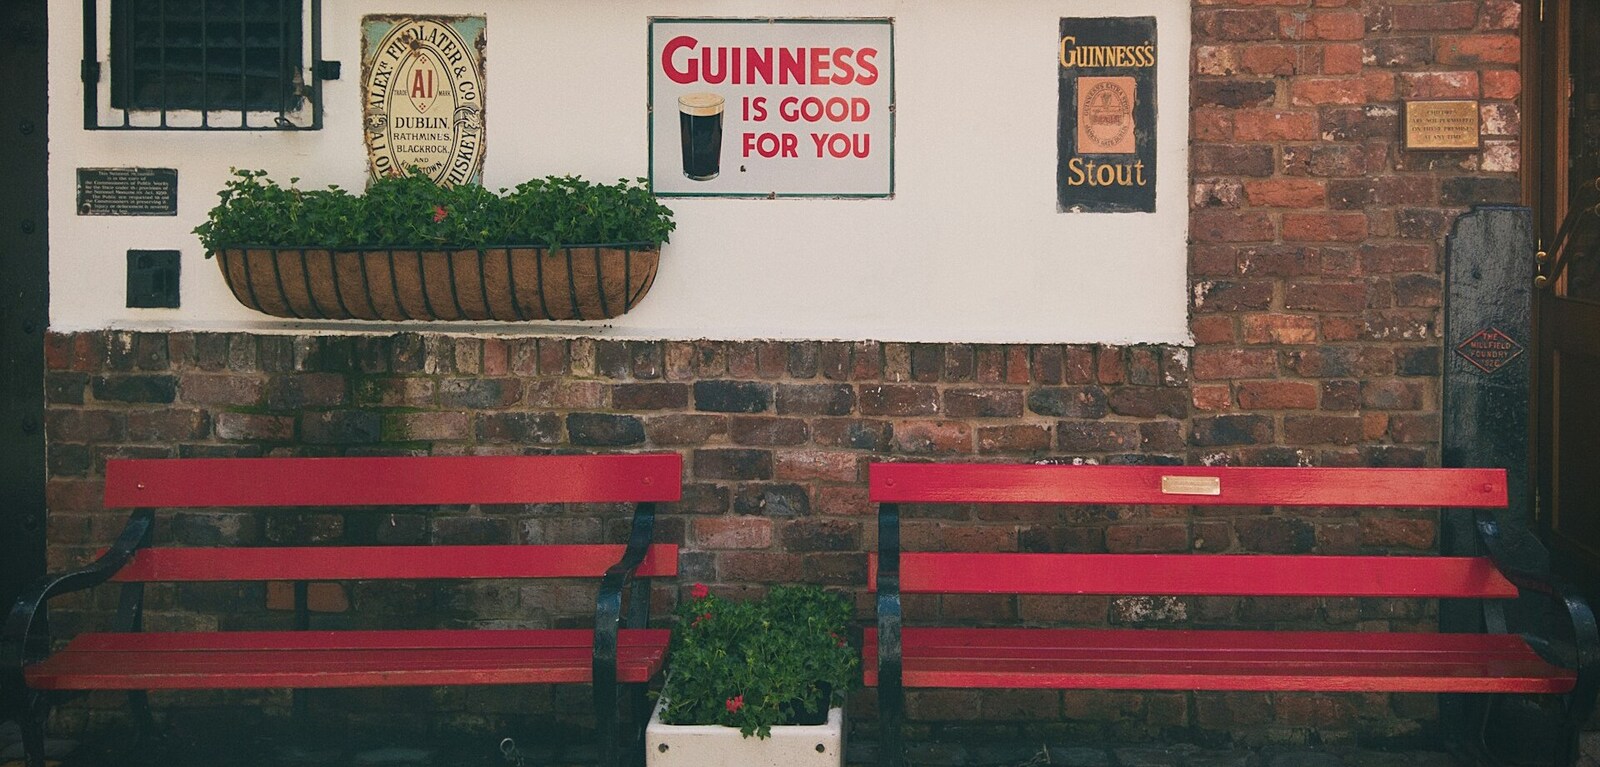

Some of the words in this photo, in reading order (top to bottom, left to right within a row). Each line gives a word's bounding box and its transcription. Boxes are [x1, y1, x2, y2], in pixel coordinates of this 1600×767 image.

[454, 66, 467, 79] &
[661, 35, 879, 86] GUINNESS
[742, 96, 768, 122] IS
[779, 96, 871, 123] GOOD
[742, 133, 799, 158] FOR
[810, 133, 870, 158] YOU
[1068, 157, 1147, 187] Stout
